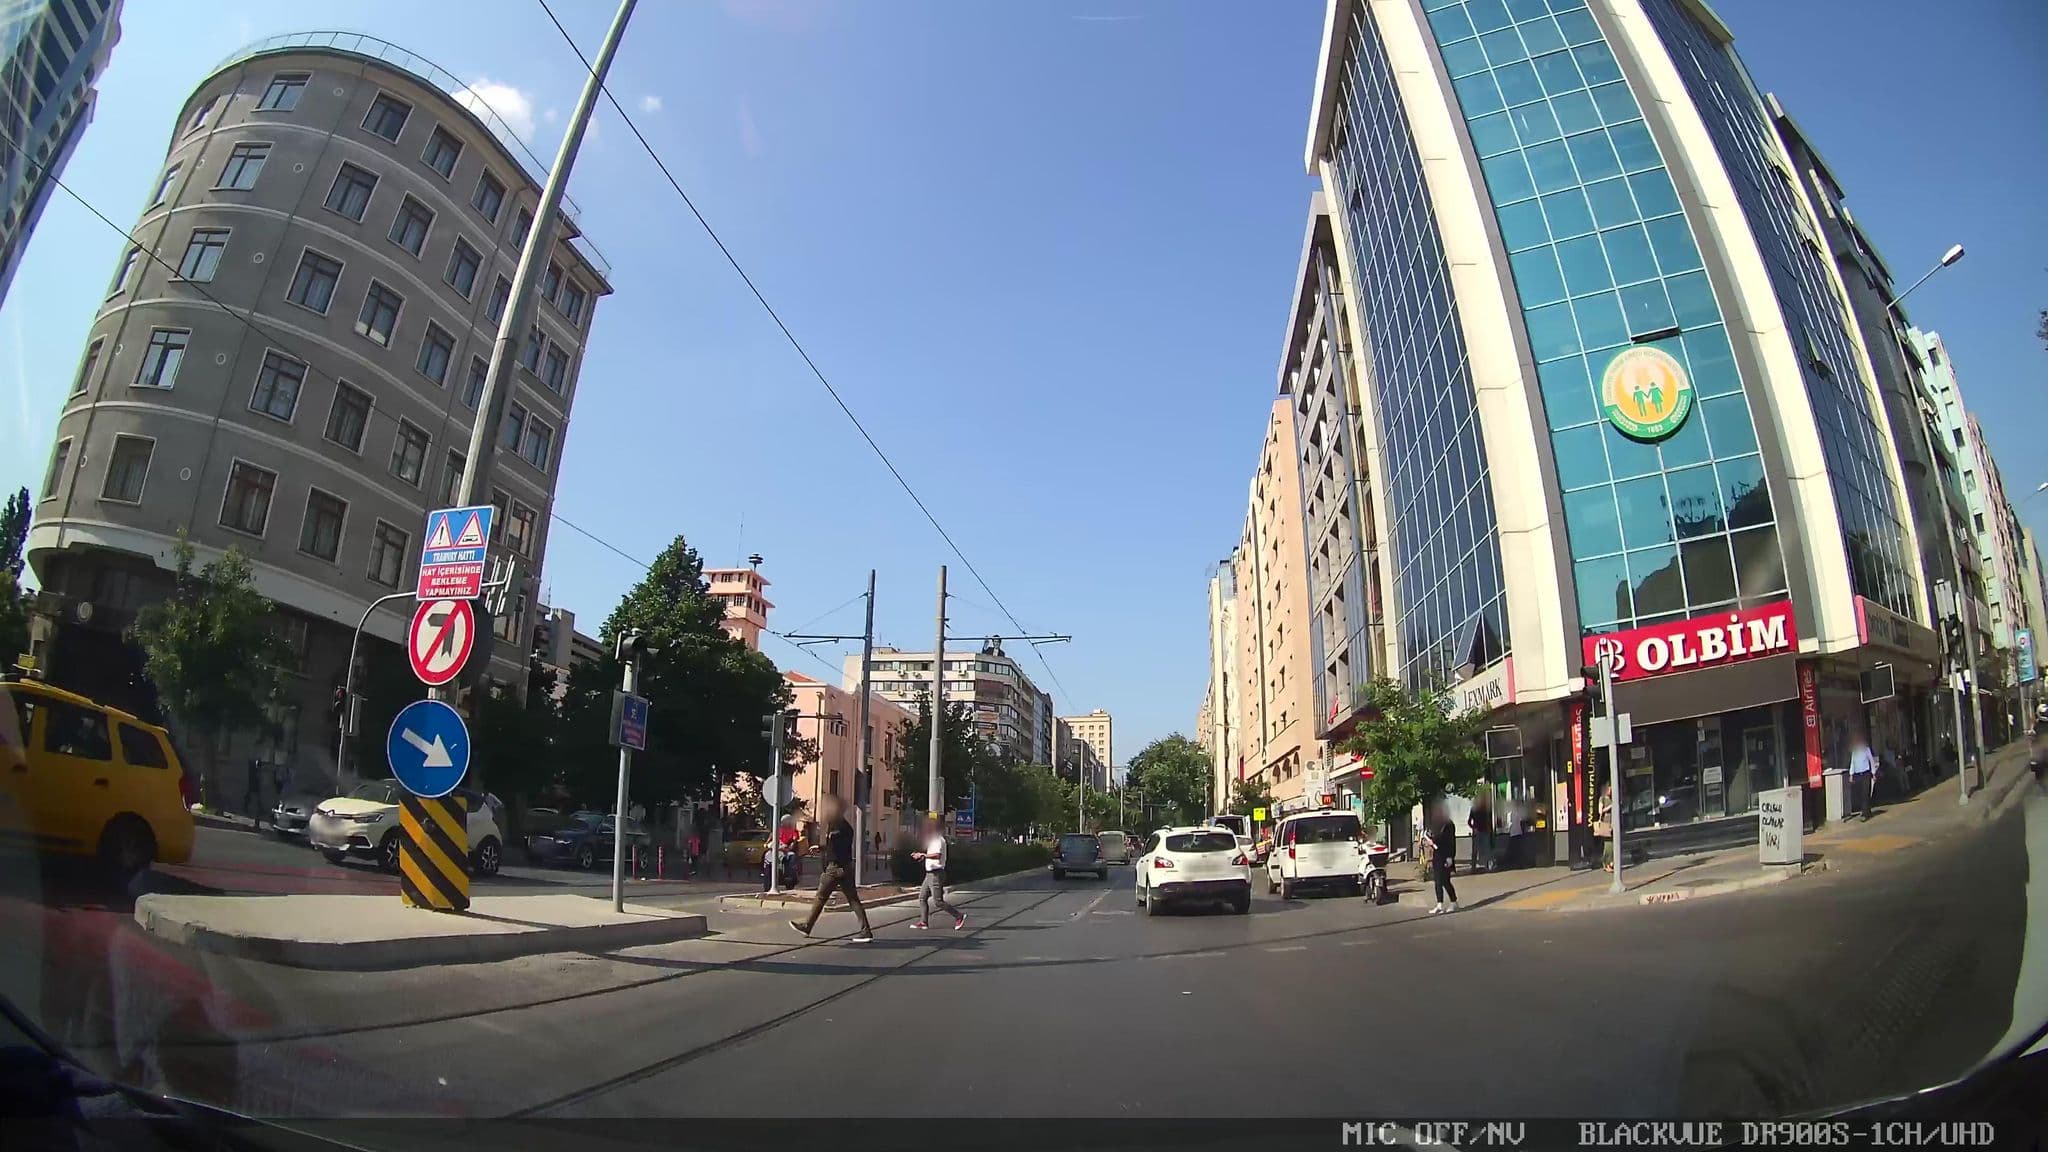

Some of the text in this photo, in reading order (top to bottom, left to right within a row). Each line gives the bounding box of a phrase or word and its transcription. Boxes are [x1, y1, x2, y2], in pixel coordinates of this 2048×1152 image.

[423, 568, 436, 576] HAT
[432, 577, 467, 585] BEKLEME
[1636, 613, 1790, 671] OLBİM
[1463, 677, 1502, 711] LEXMARK
